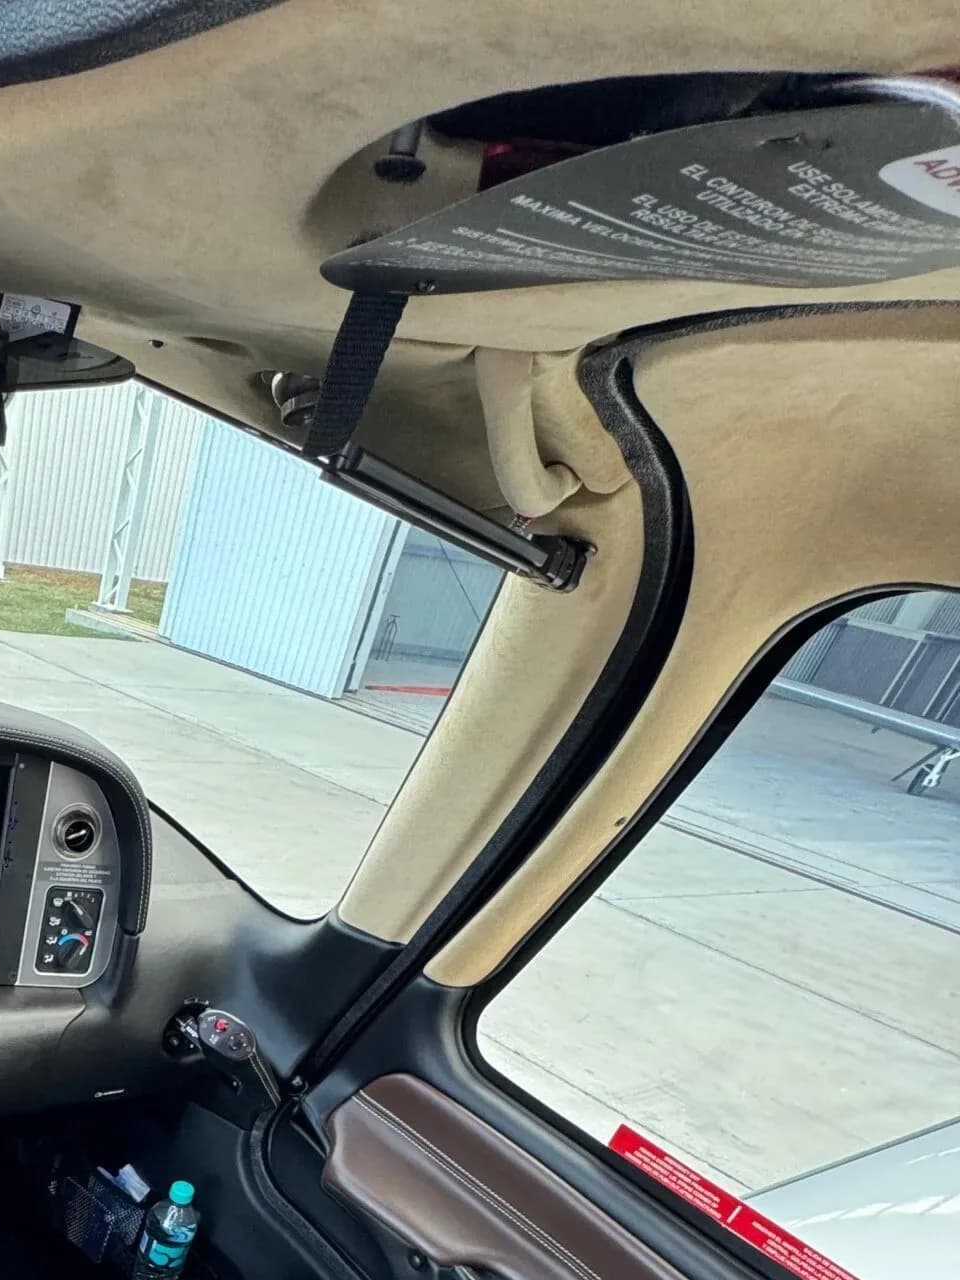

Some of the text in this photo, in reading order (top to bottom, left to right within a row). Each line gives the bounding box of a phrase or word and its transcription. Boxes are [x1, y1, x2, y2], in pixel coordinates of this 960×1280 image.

[788, 161, 832, 186] USE
[680, 163, 709, 181] EL
[706, 177, 796, 221] CINTURON
[510, 194, 583, 226] MAXIMA
[632, 193, 659, 209] EL
[657, 204, 699, 224] USO
[696, 189, 785, 231] UTILIZADO
